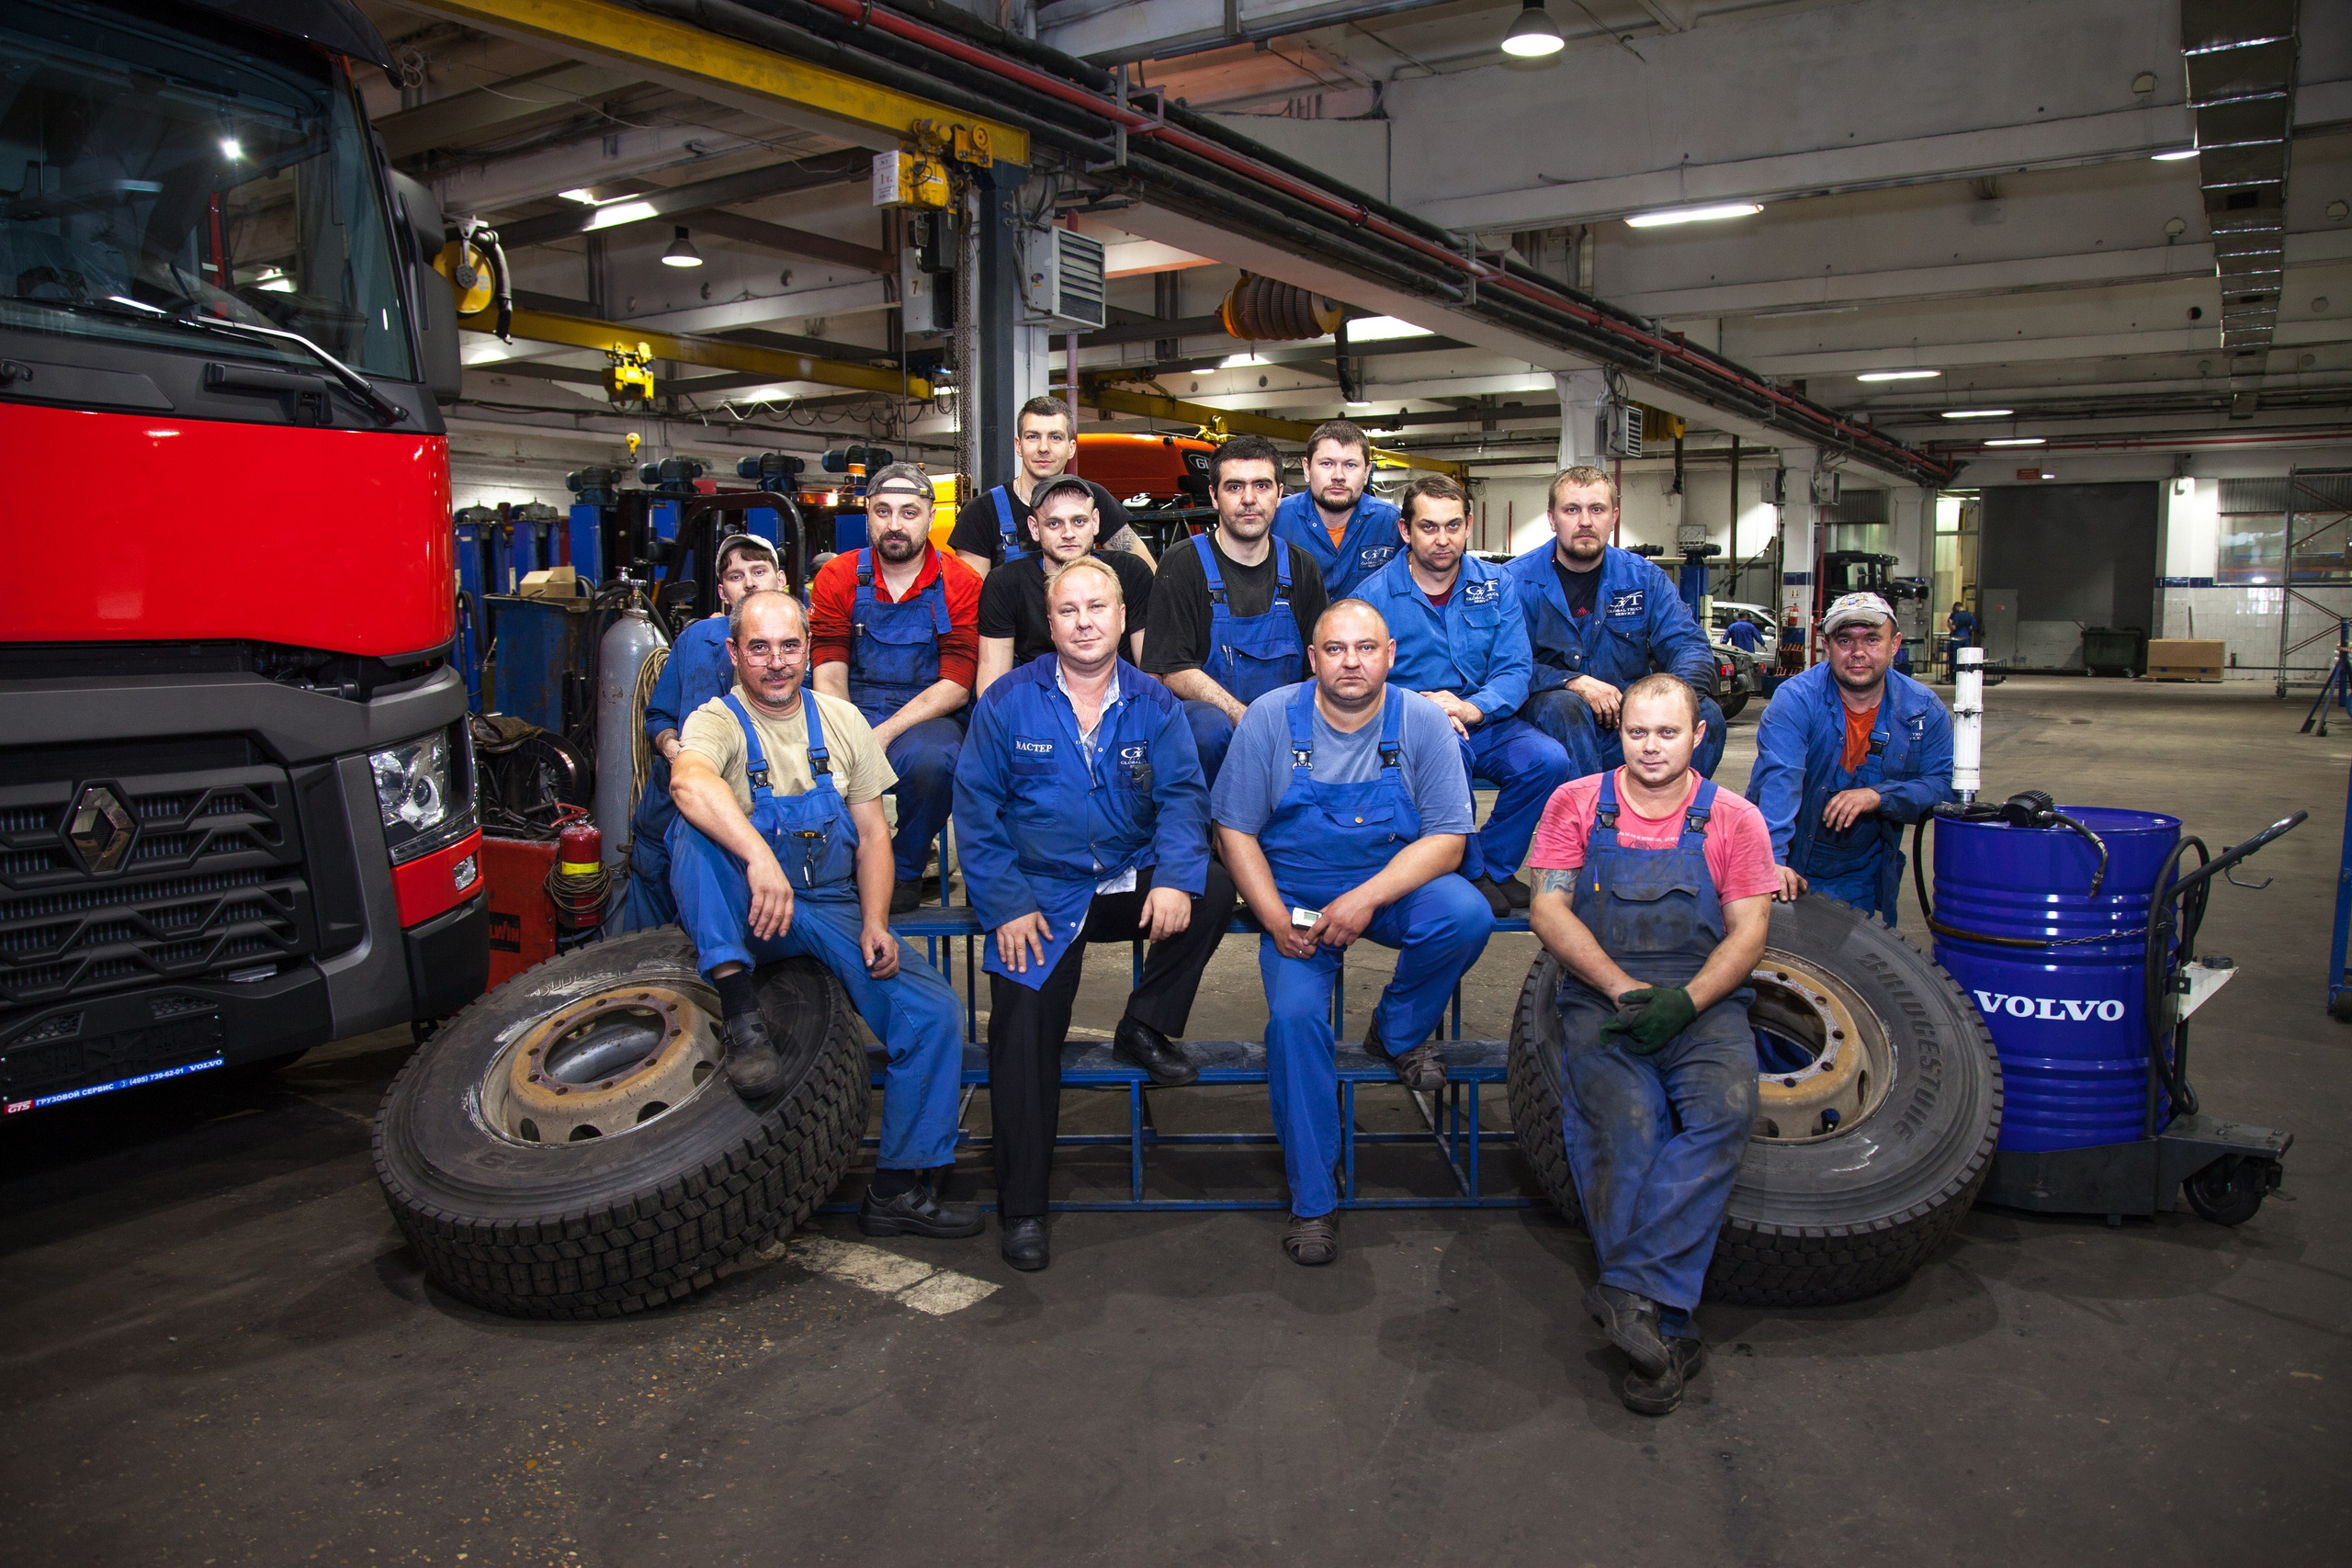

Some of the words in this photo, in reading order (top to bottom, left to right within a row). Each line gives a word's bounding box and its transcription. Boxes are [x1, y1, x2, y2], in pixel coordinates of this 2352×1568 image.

[911, 279, 919, 295] 7
[489, 919, 520, 943] LWIN
[1973, 989, 2125, 1021] VOLVO
[1852, 952, 1943, 1145] BRIDGESTONE
[189, 1059, 222, 1072] VOLVO
[130, 1076, 148, 1086] (495)
[36, 1090, 80, 1106] ГРУЗОВОЙ
[82, 1083, 114, 1096] СЕРВИС
